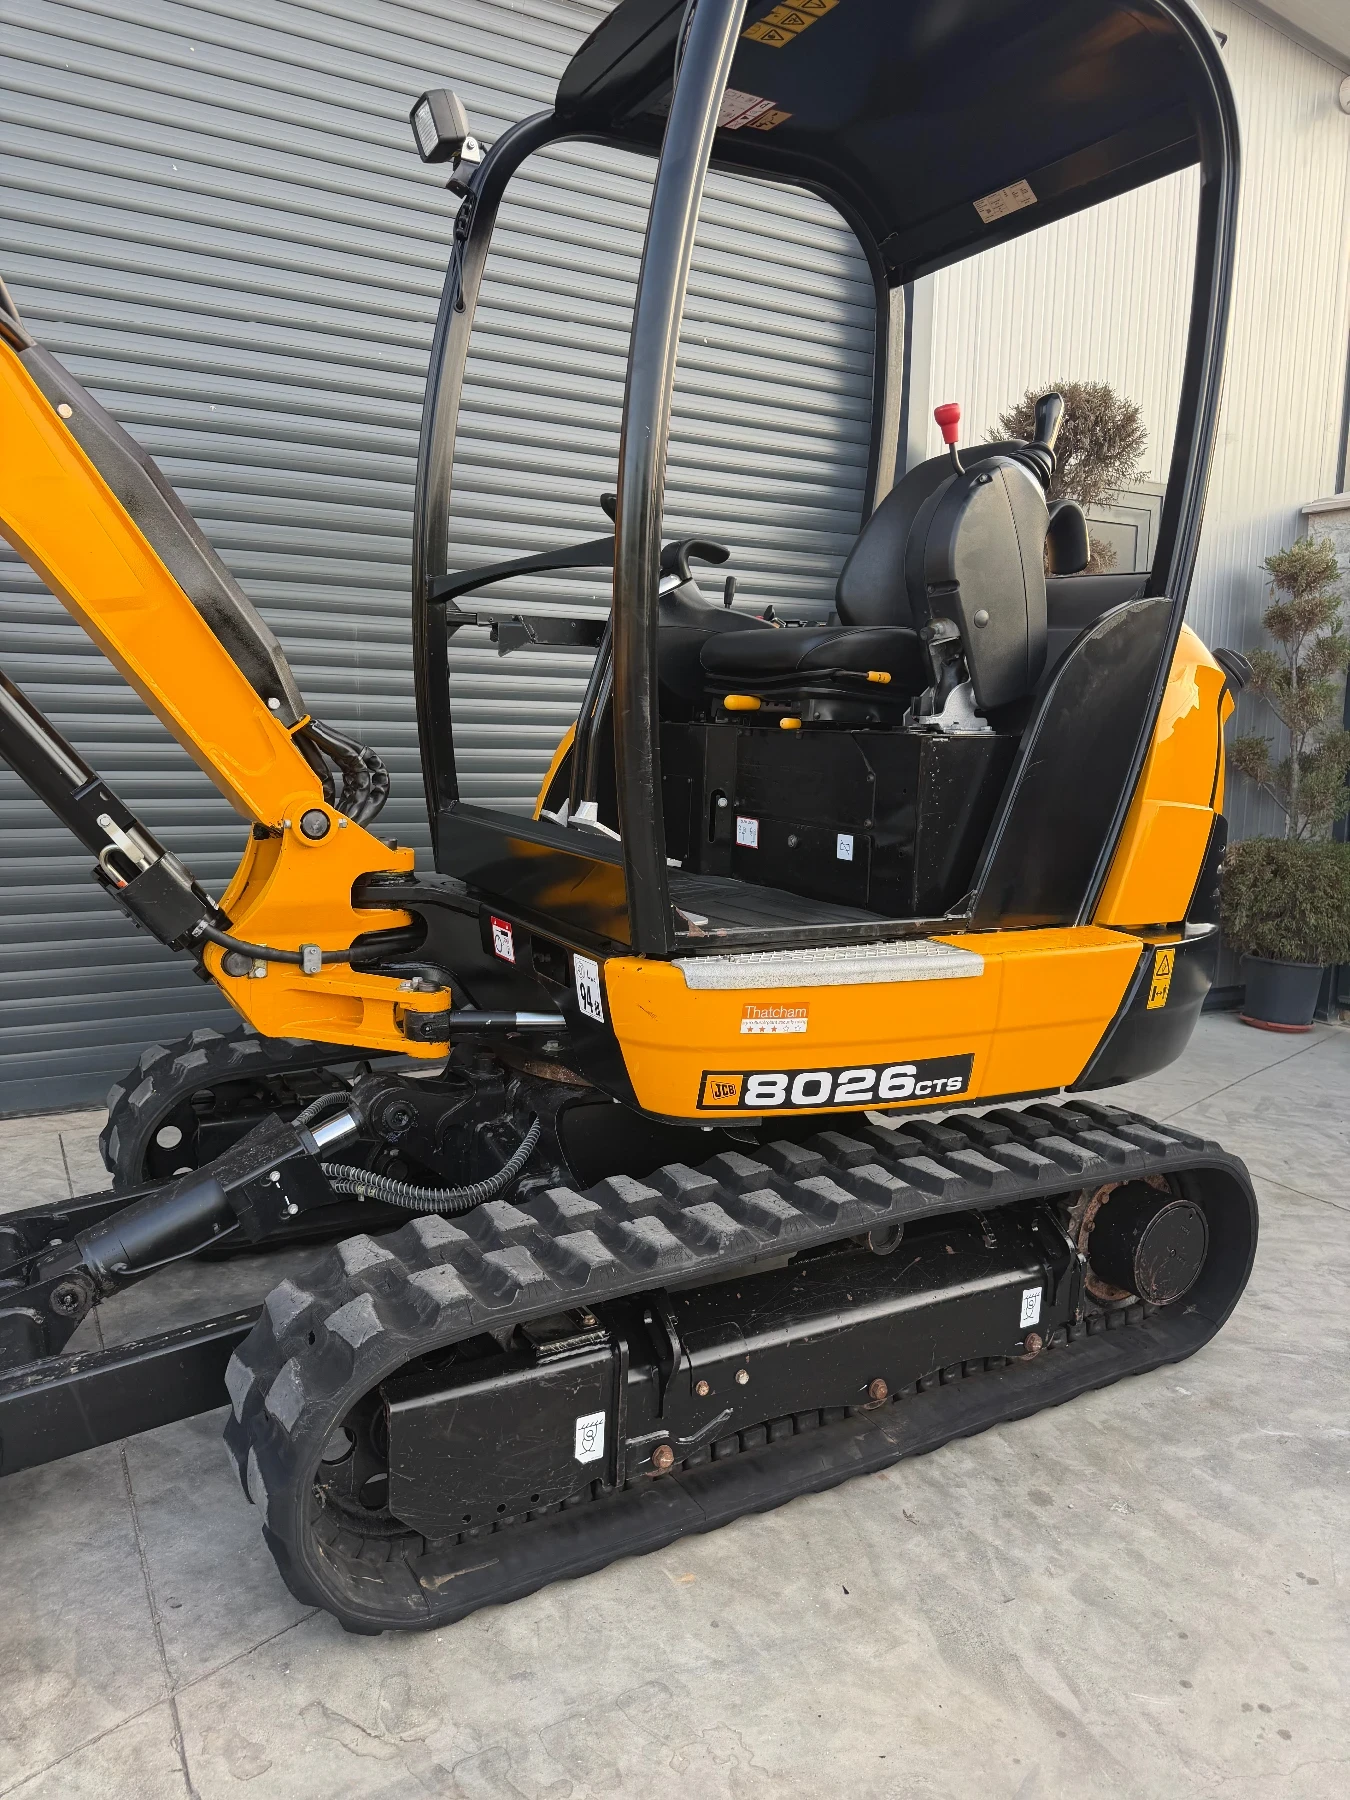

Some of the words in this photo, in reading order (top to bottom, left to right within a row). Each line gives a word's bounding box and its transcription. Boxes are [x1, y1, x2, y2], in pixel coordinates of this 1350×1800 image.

[580, 982, 594, 1014] 94
[745, 1005, 807, 1018] Thatcham
[713, 1082, 736, 1099] JCB
